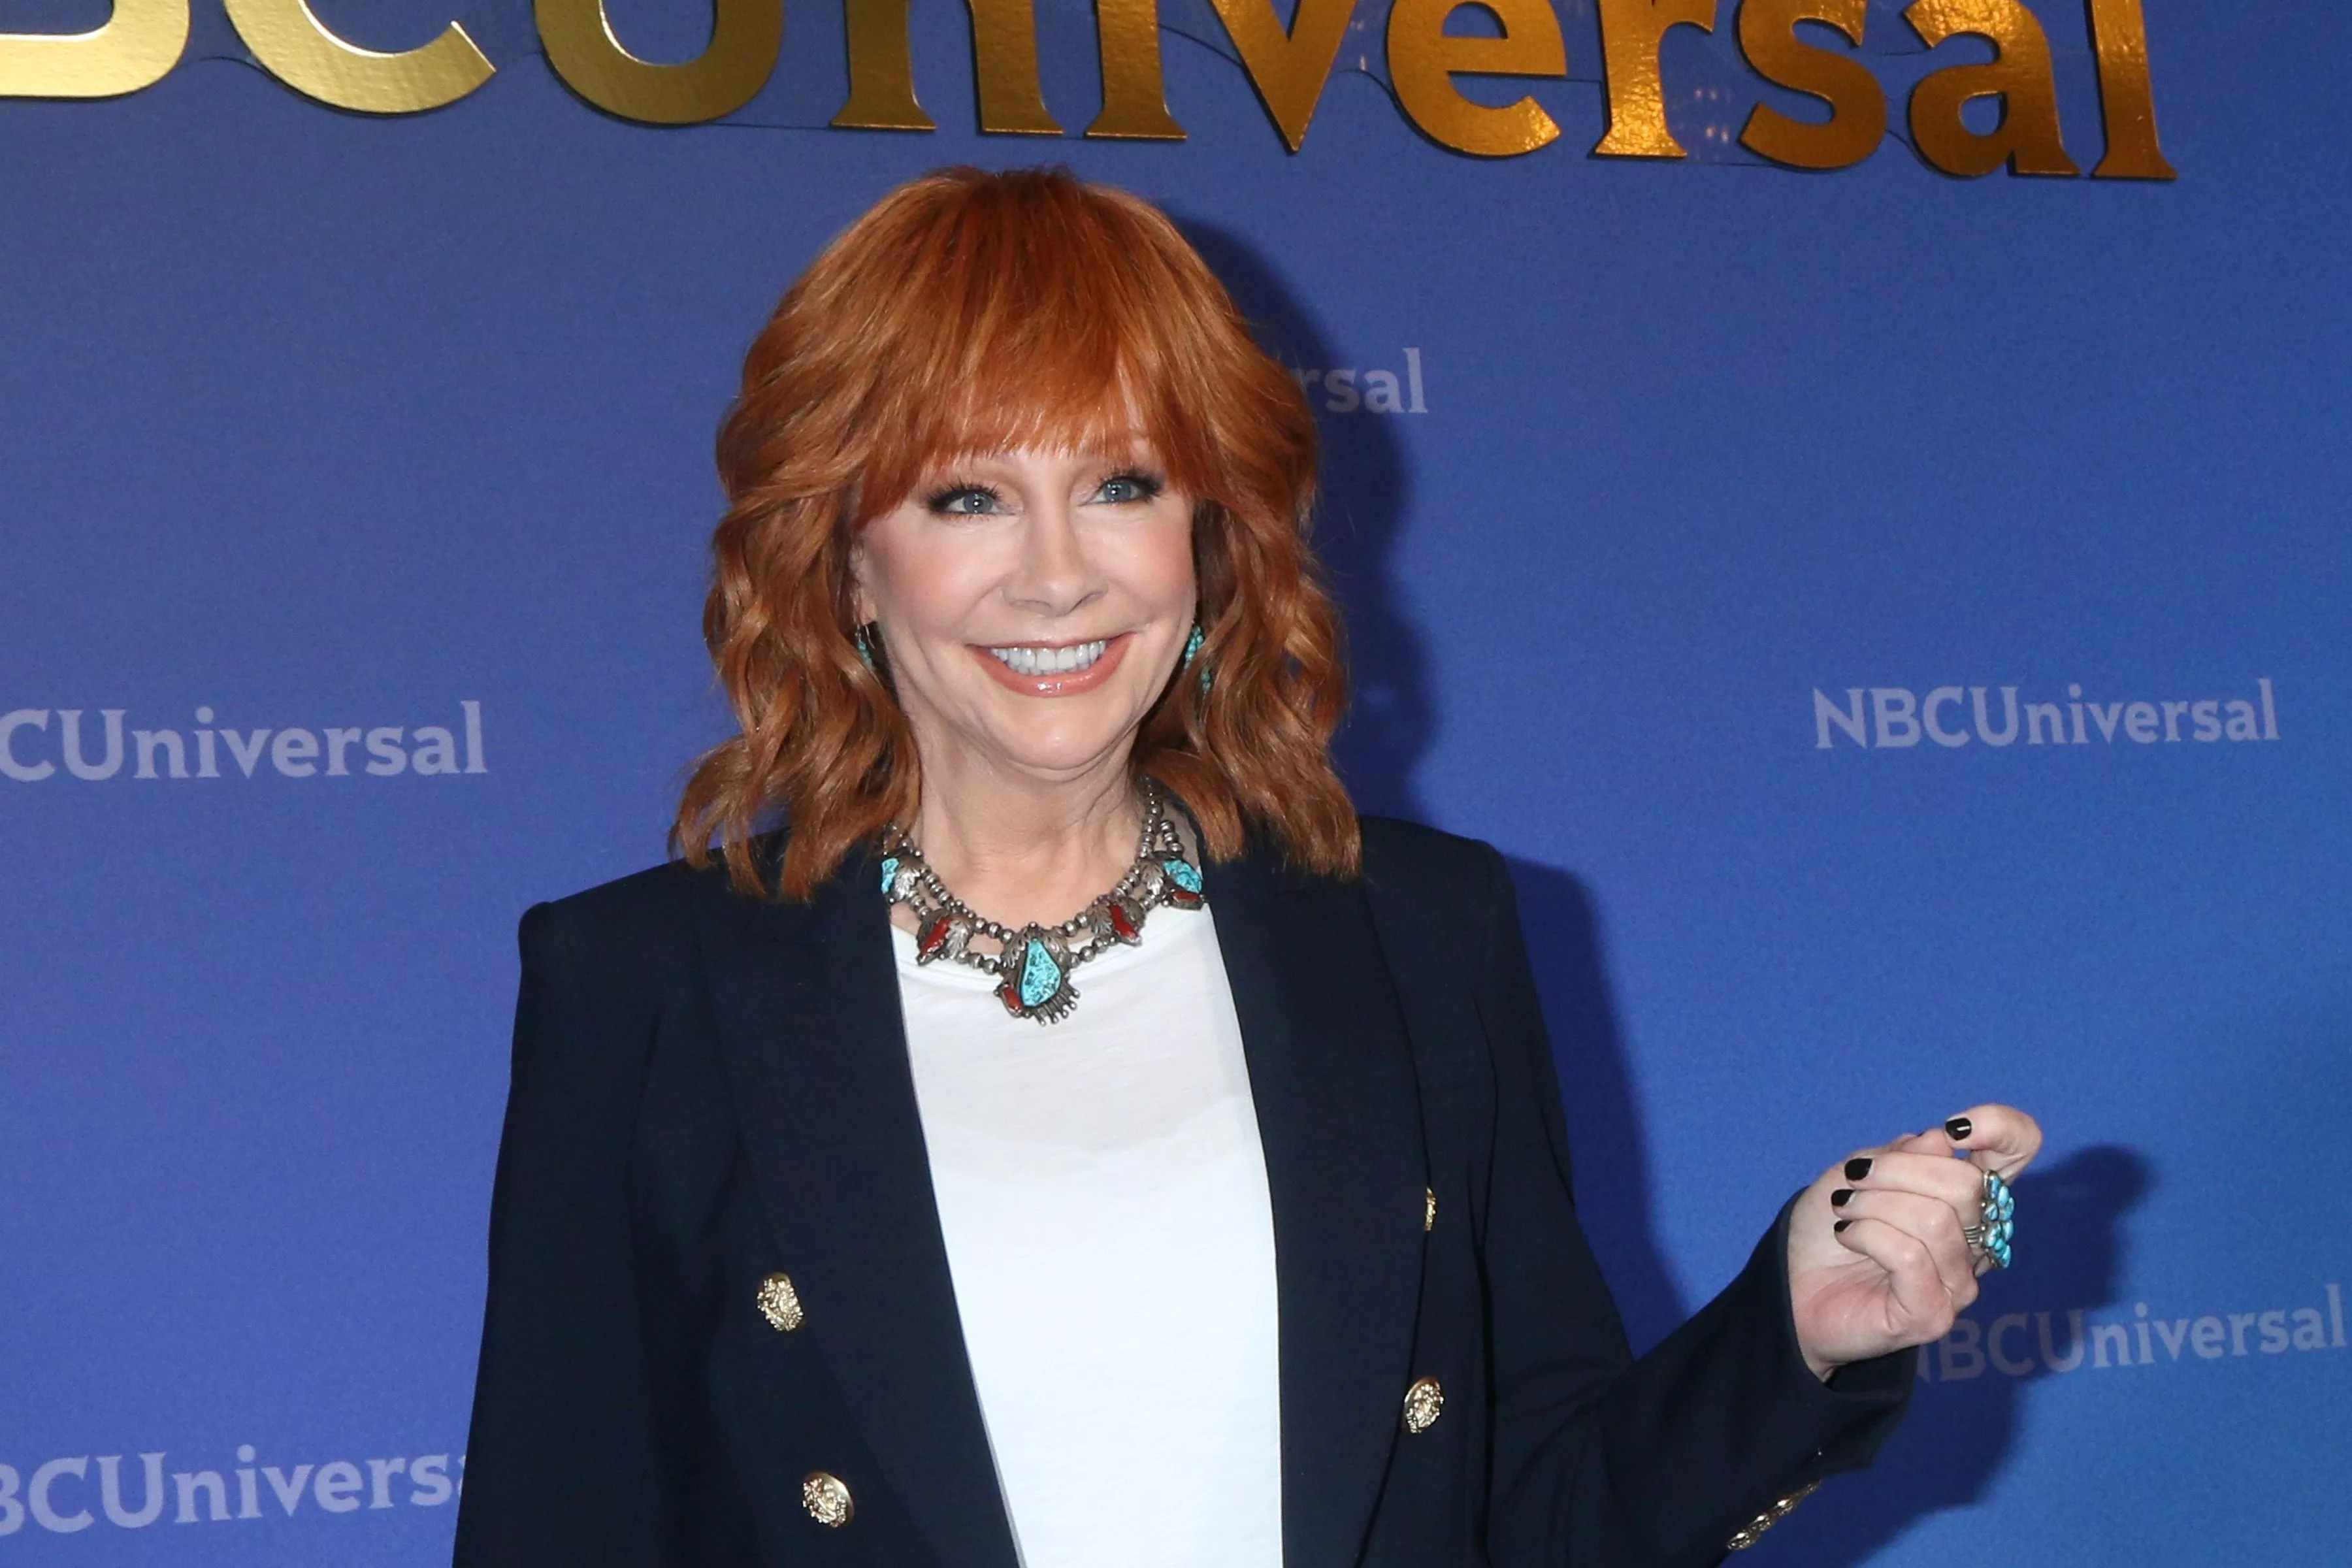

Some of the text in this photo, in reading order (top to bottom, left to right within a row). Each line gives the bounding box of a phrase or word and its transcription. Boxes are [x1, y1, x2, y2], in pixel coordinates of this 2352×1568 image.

[0, 700, 488, 781] CUniversal
[1813, 677, 2281, 749] NBCUniversal
[0, 1444, 466, 1536] CUnivers
